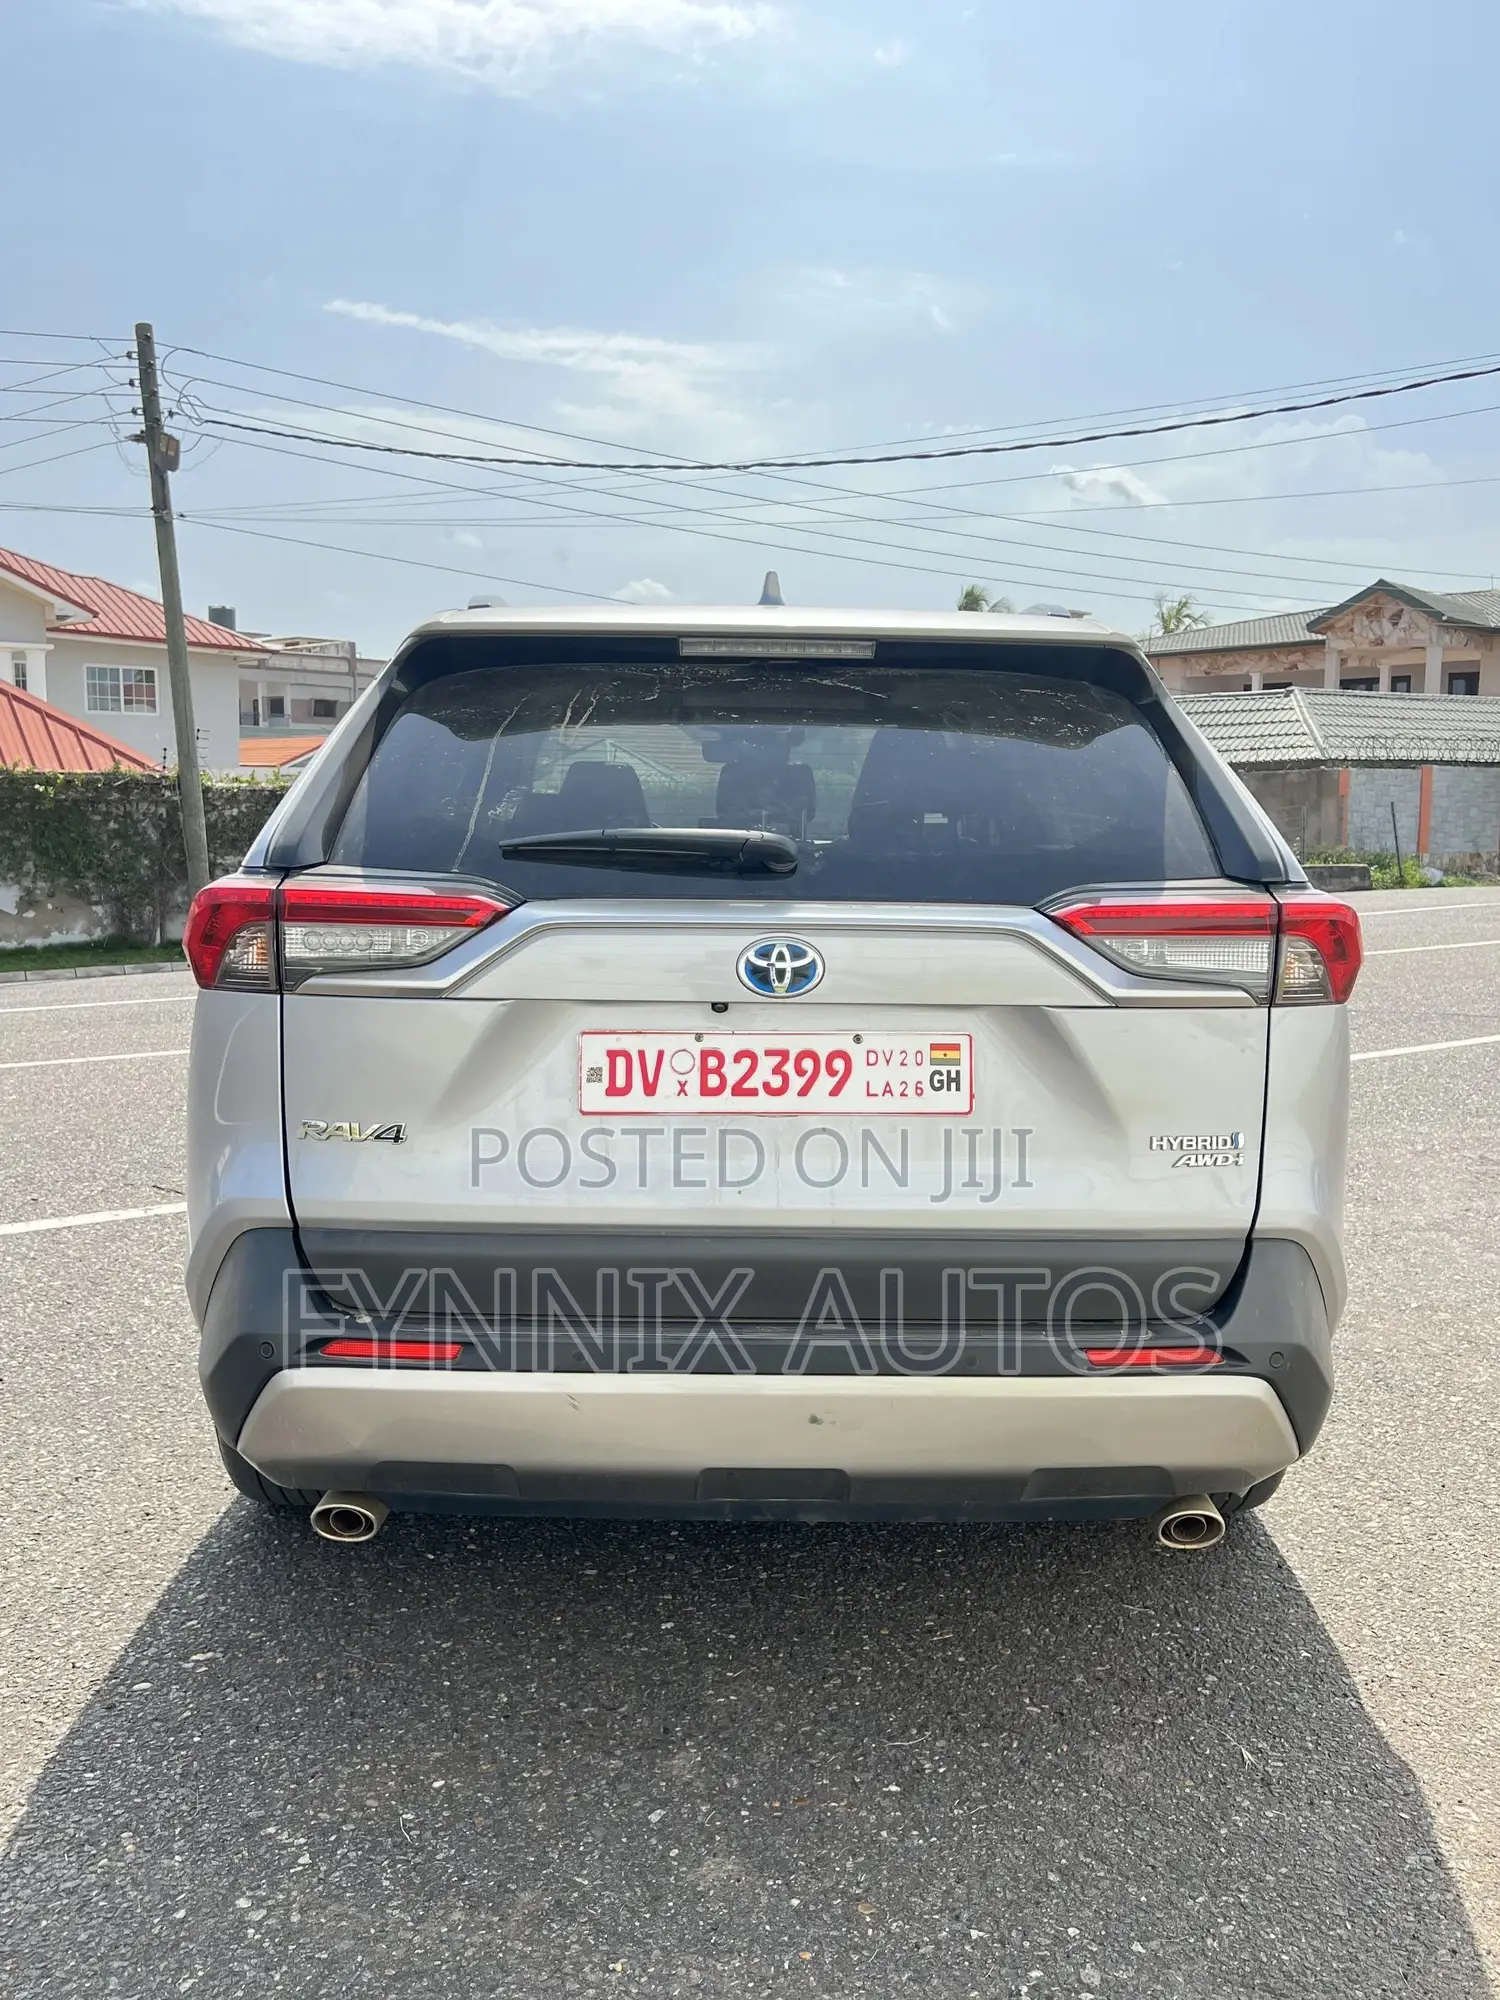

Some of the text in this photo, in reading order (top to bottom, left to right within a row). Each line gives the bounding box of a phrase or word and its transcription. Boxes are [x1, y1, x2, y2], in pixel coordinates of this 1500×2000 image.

[605, 1049, 664, 1097] DV
[700, 1049, 853, 1097] B2399
[929, 1069, 961, 1092] GH
[297, 1119, 408, 1145] RAV4
[1150, 1135, 1232, 1150] HYBRID
